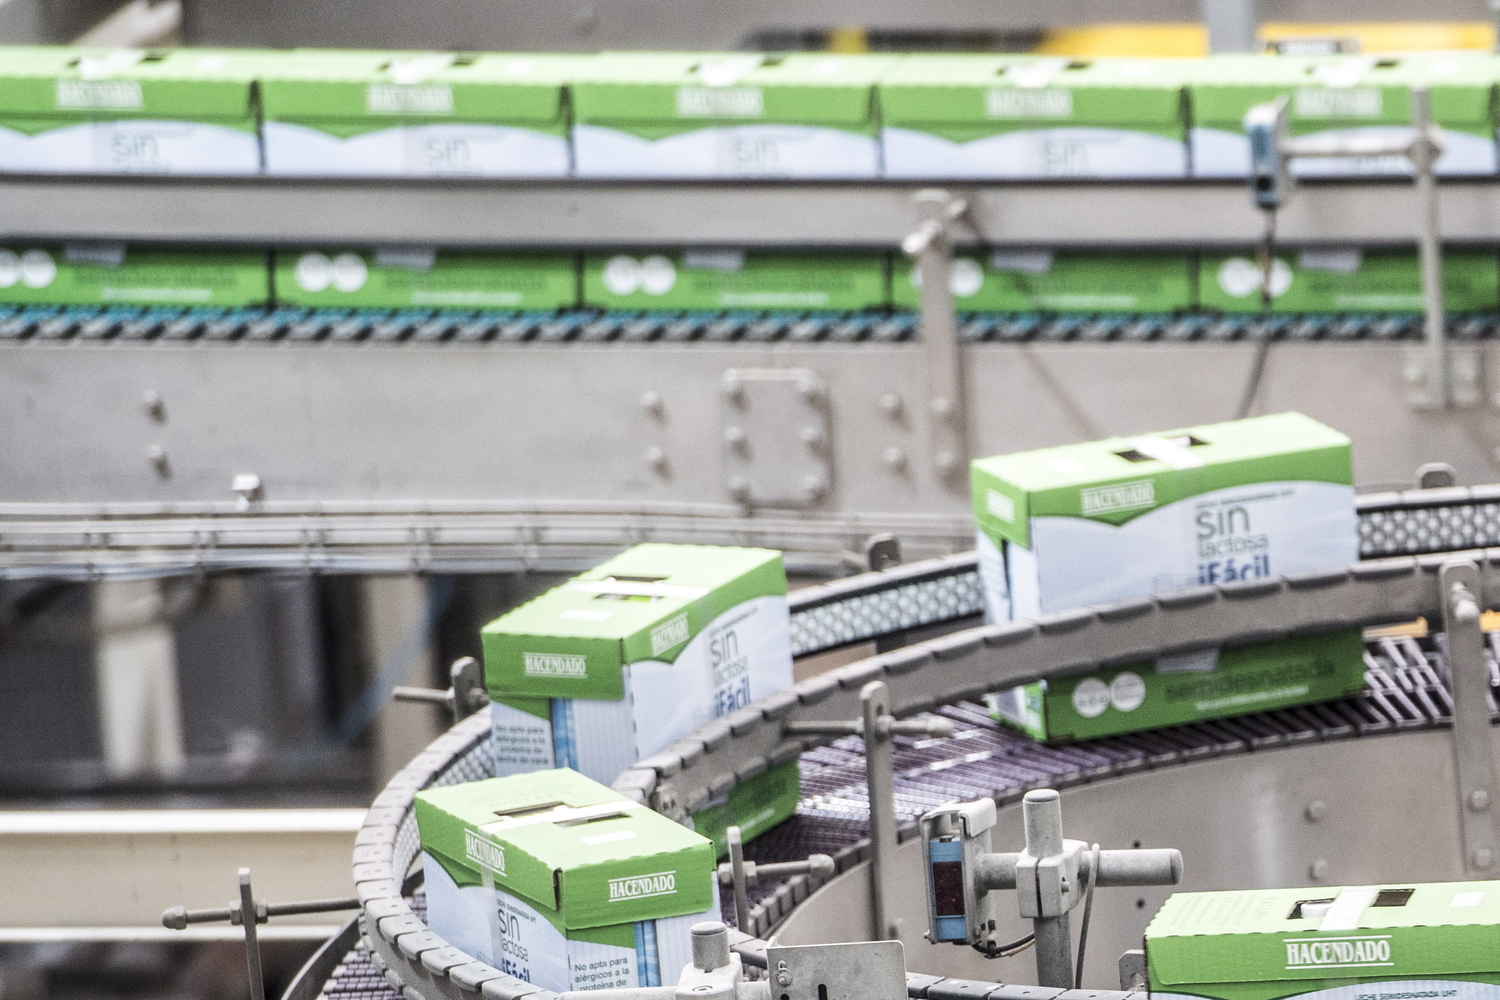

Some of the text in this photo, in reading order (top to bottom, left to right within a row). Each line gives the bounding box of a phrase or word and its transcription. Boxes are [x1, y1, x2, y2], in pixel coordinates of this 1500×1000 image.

[1194, 505, 1250, 540] sin
[710, 630, 739, 668] sin
[524, 654, 586, 676] HACENDADO
[609, 874, 675, 899] HACENDADO
[497, 908, 521, 942] sin
[574, 957, 628, 972] No apta para
[1286, 939, 1392, 966] HACENDADO
[574, 970, 613, 983] alérgicos
[621, 967, 630, 975] la
[615, 978, 627, 987] de
